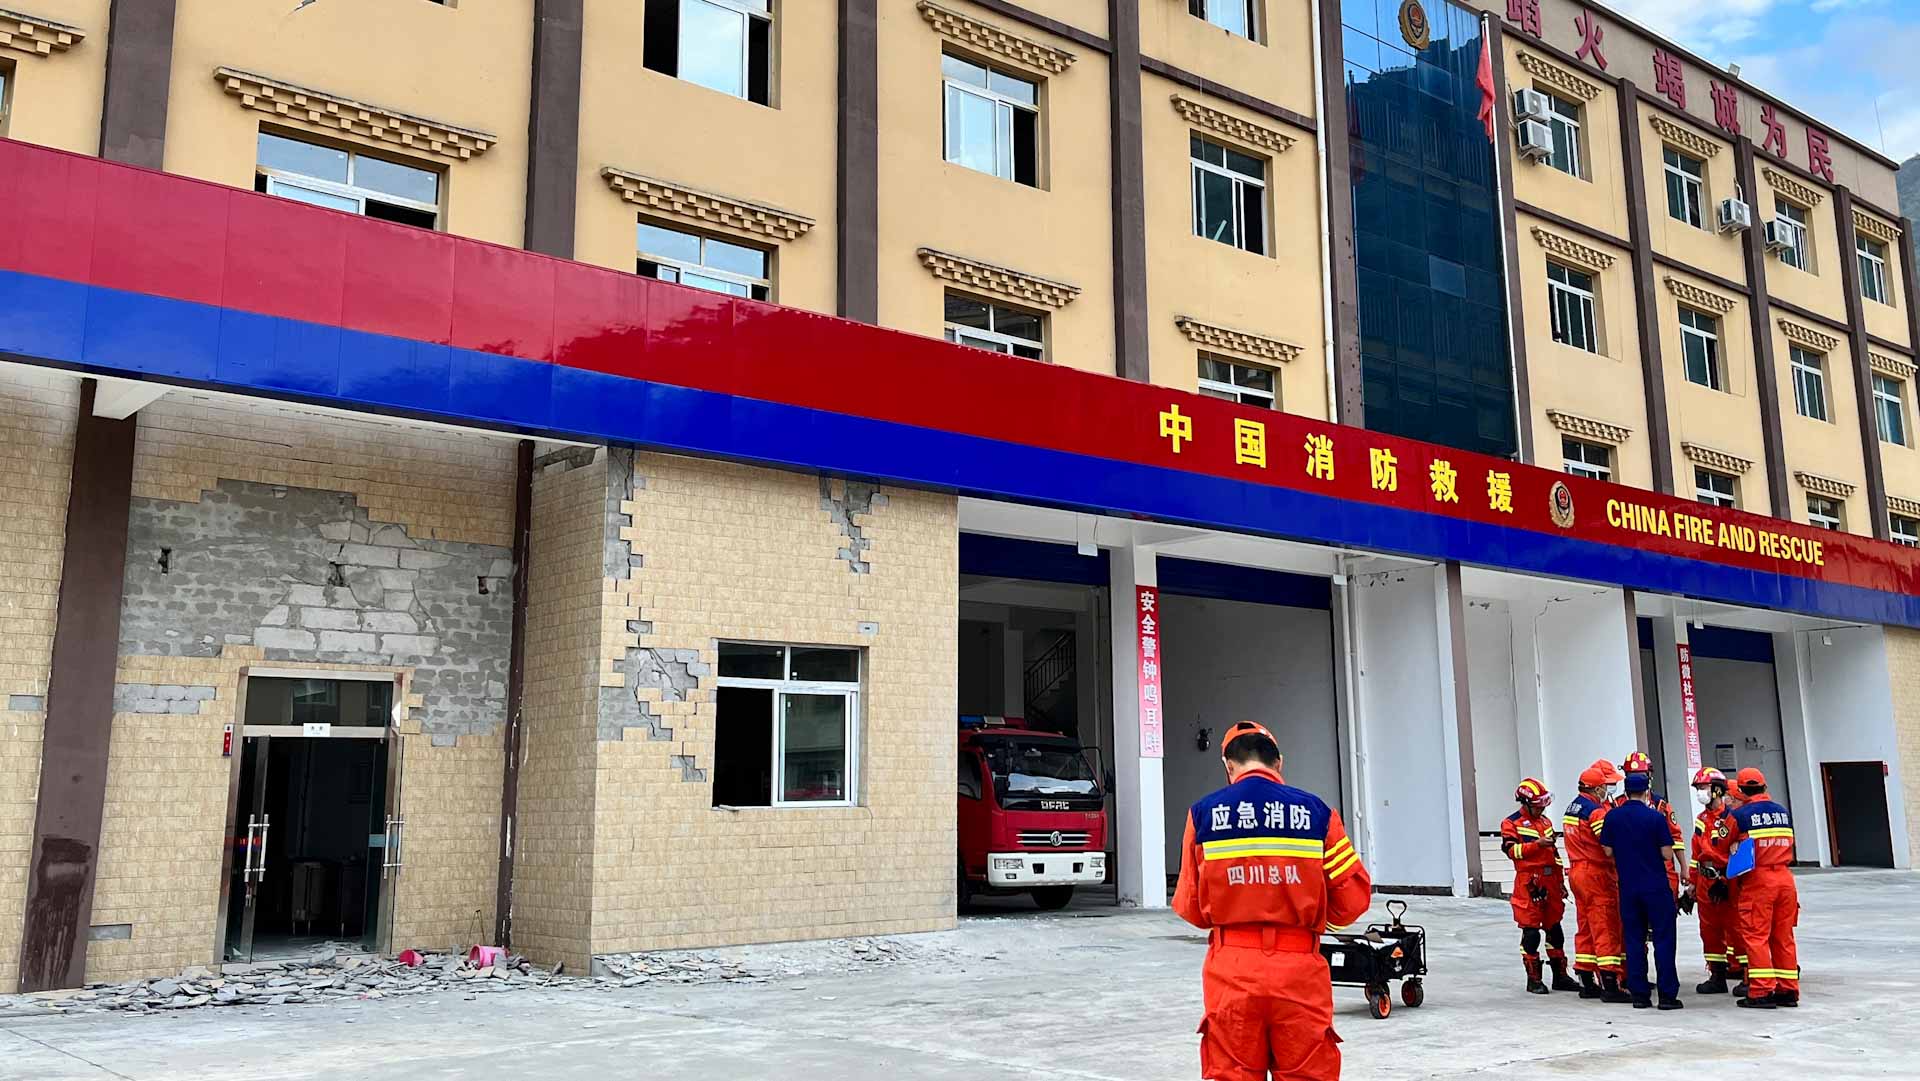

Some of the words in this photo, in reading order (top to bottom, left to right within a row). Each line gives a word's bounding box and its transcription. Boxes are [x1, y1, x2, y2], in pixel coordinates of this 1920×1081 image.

[1159, 404, 1514, 513] 中国消防救援
[1606, 499, 1671, 538] CHINA
[1674, 513, 1714, 546] FIRE
[1717, 523, 1755, 553] AND
[1759, 534, 1825, 566] RESCUE
[1211, 801, 1311, 831] 应急消防
[1751, 812, 1789, 826] 应急消防
[1227, 864, 1301, 885] 四川总队
